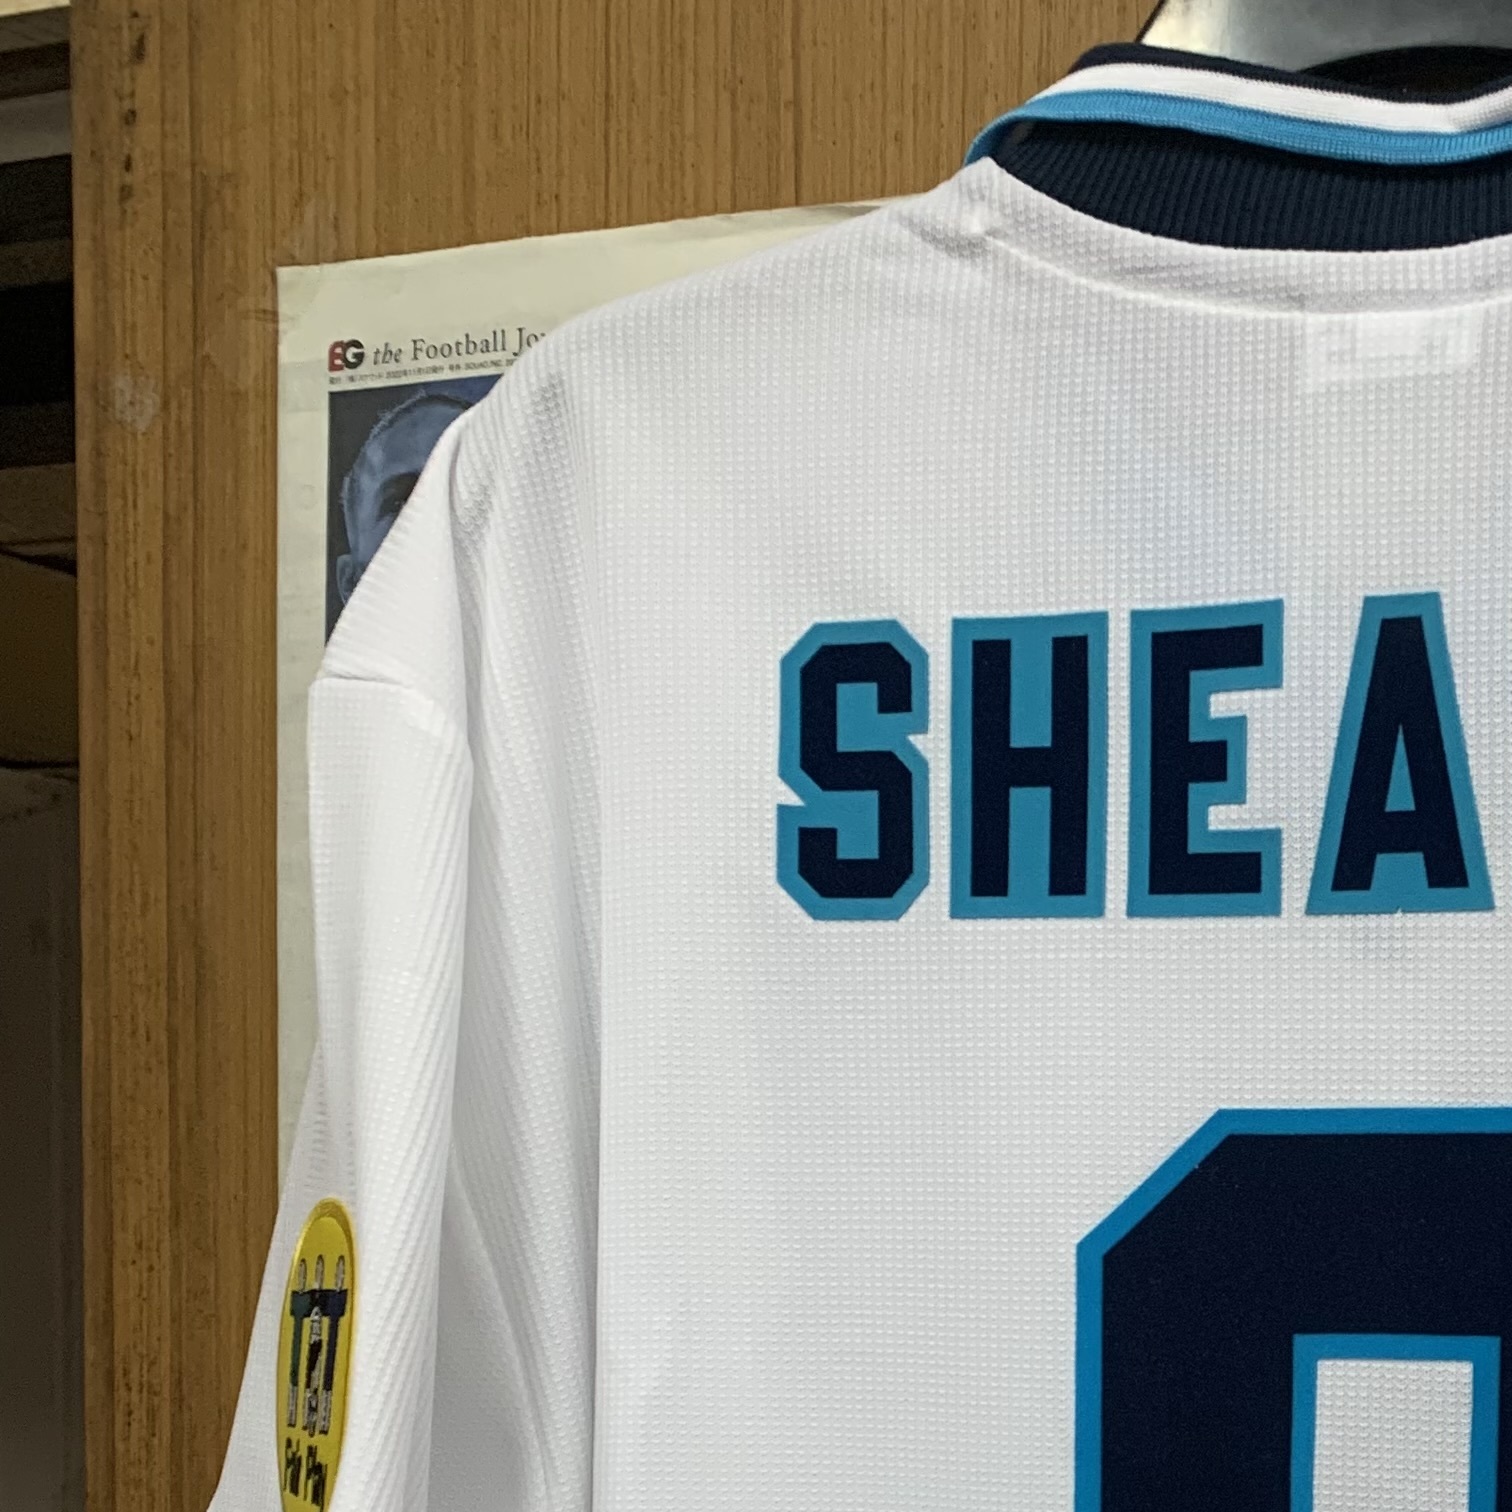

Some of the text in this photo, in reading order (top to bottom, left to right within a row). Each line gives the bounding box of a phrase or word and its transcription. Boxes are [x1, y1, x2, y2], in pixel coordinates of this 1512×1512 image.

[328, 327, 545, 372] EG the Football Jo
